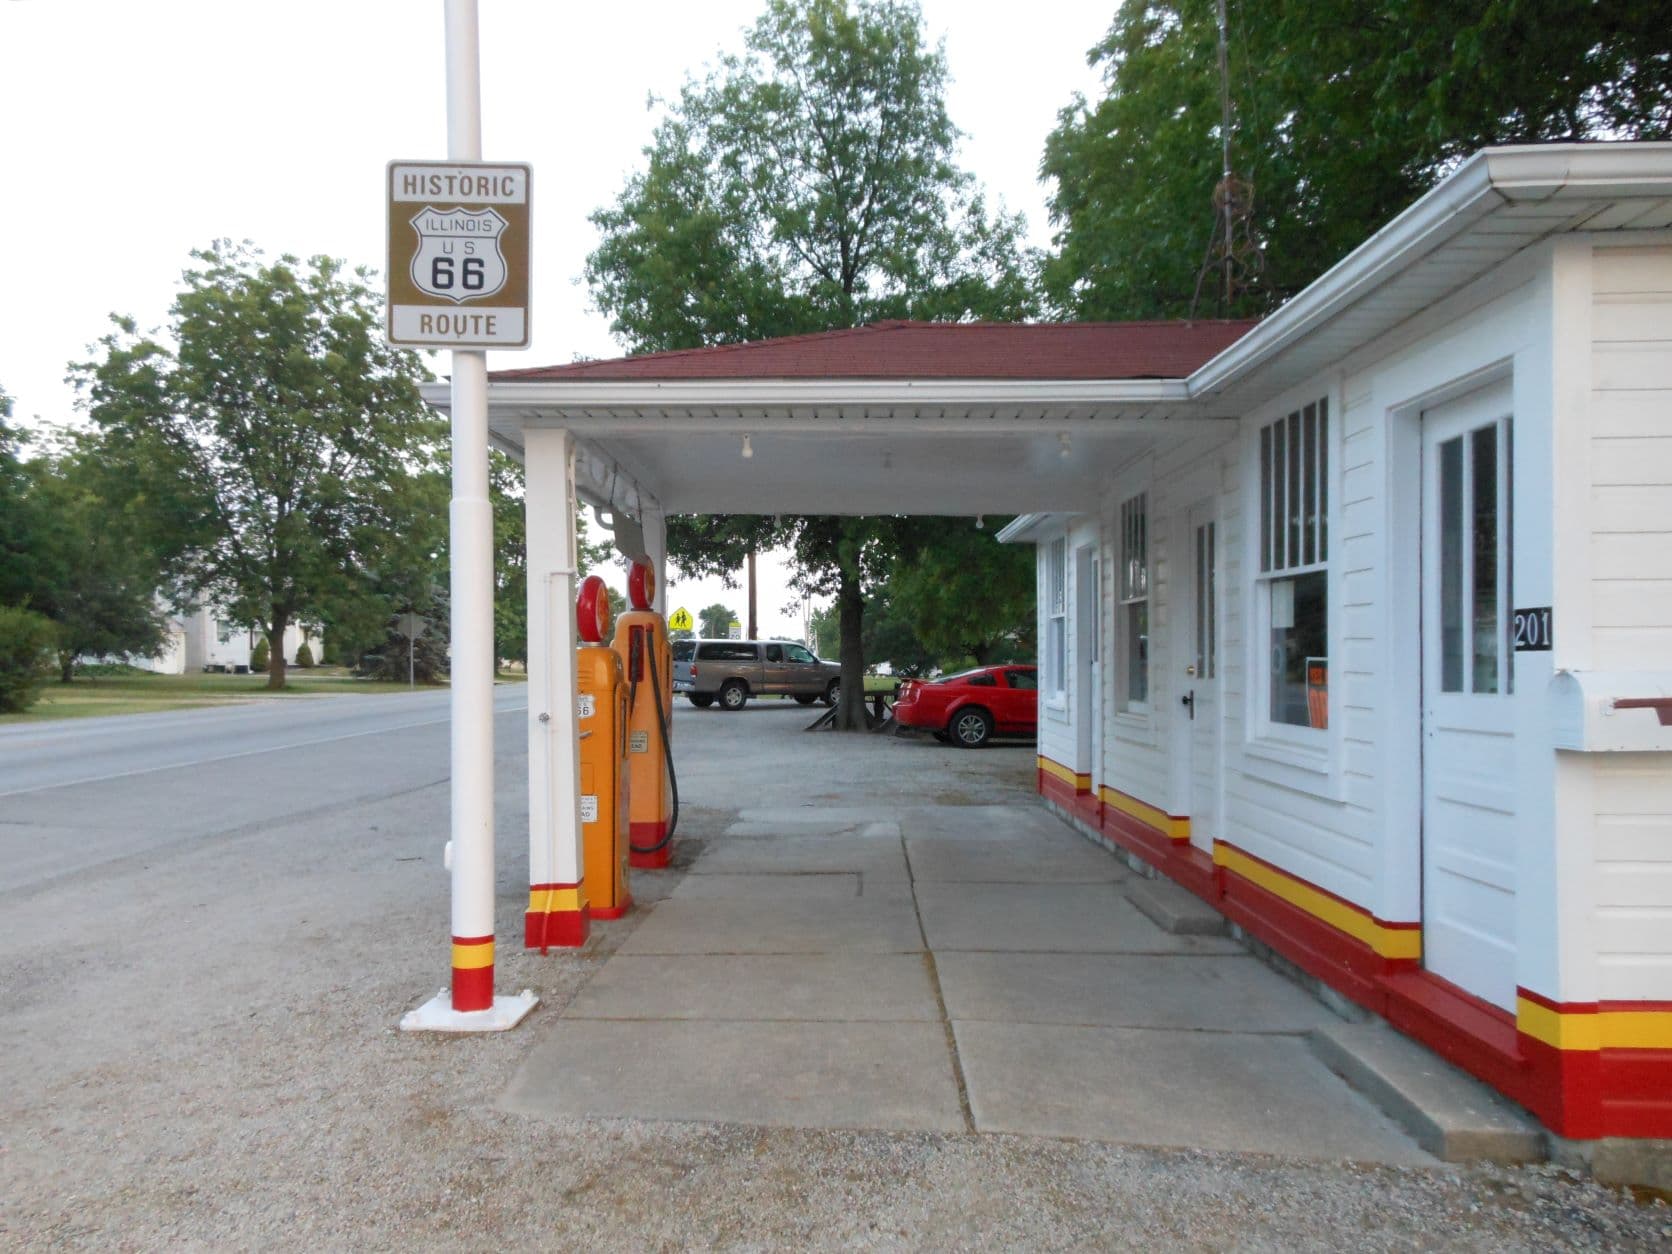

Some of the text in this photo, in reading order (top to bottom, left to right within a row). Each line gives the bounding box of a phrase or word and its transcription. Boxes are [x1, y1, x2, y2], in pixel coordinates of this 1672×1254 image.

[403, 174, 514, 197] HISTORIC
[425, 219, 492, 232] ILLINOIS
[432, 257, 484, 290] 66
[420, 314, 497, 335] ROUTE
[1515, 612, 1549, 646] 201
